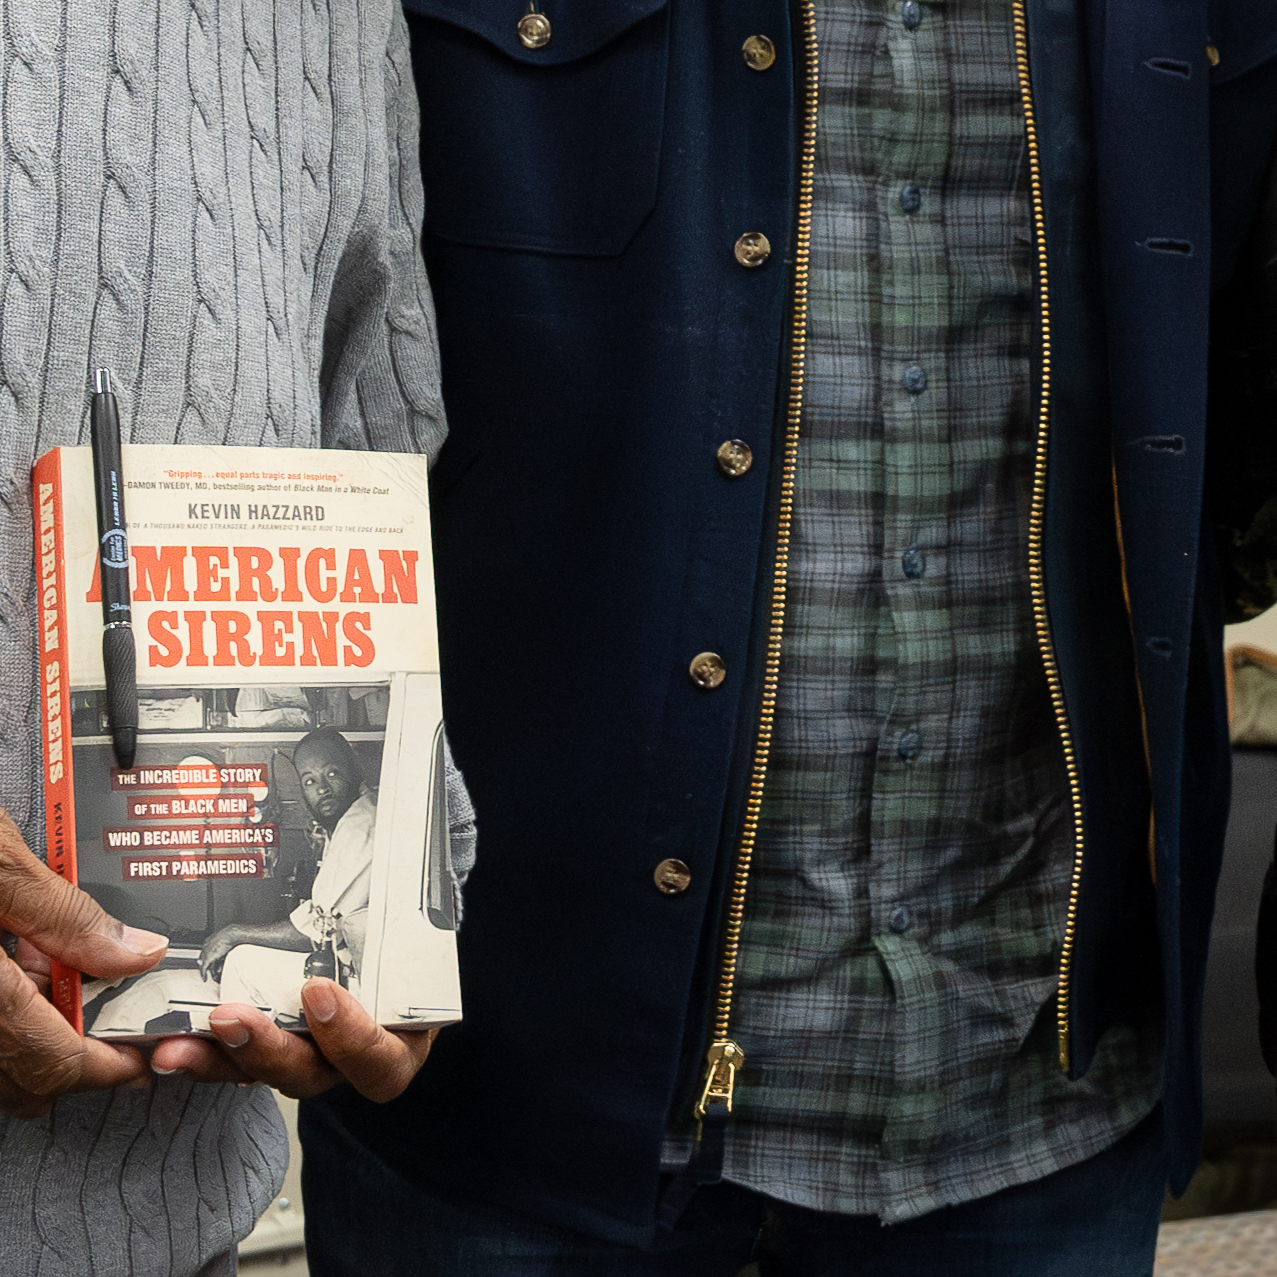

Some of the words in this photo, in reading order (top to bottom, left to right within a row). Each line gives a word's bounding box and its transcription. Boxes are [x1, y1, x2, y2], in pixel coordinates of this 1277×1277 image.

[240, 471, 260, 480] parts
[262, 471, 285, 481] tragic
[287, 472, 301, 480] and
[158, 481, 193, 491] TWEEDY,
[195, 482, 211, 491] MD,
[213, 482, 255, 493] bestselling
[257, 483, 281, 492] author
[284, 484, 291, 492] of
[294, 484, 315, 492] Black
[317, 484, 333, 493] Man
[335, 485, 342, 493] in
[350, 485, 371, 494] White
[373, 486, 390, 495] Coat
[188, 503, 241, 520] KEVIN
[248, 504, 325, 521] HAZZARD
[39, 482, 59, 653] AMERICAN
[147, 609, 376, 668] SIRENS
[45, 660, 64, 785] SIRENS
[117, 775, 137, 785] THE
[140, 769, 217, 784] INCREDIBLE
[220, 768, 262, 782] STORY
[134, 805, 148, 815] OF
[150, 804, 169, 814] THE
[172, 799, 214, 814] BLACK
[218, 798, 247, 813] MEN
[108, 831, 140, 847] WHO
[144, 830, 200, 845] BECAME
[203, 828, 274, 844] AMERICA'S
[130, 861, 168, 876] FIRST
[172, 859, 257, 875] PARAMEDICS
